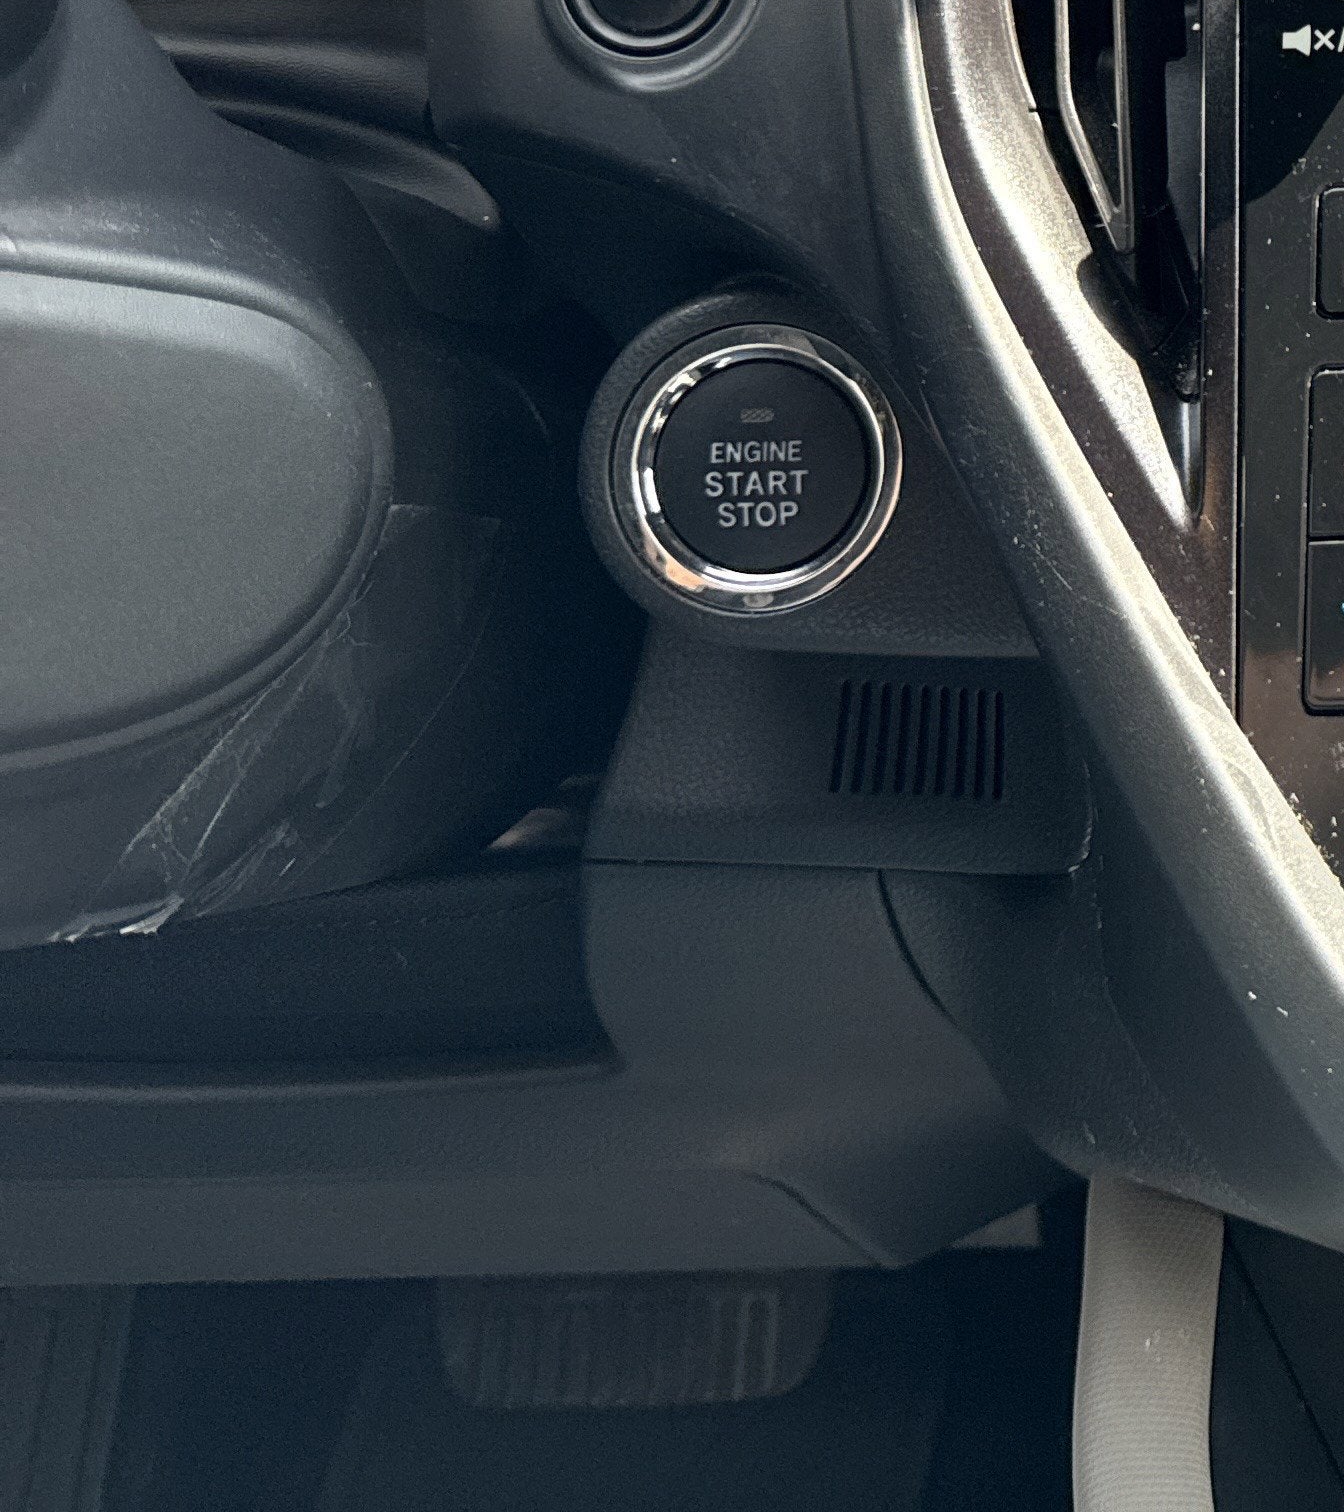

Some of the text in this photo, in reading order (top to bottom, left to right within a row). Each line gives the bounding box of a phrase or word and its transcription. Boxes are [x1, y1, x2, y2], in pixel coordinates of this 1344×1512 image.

[710, 440, 803, 464] ENGINE
[705, 470, 808, 497] START
[717, 501, 799, 529] STOP
